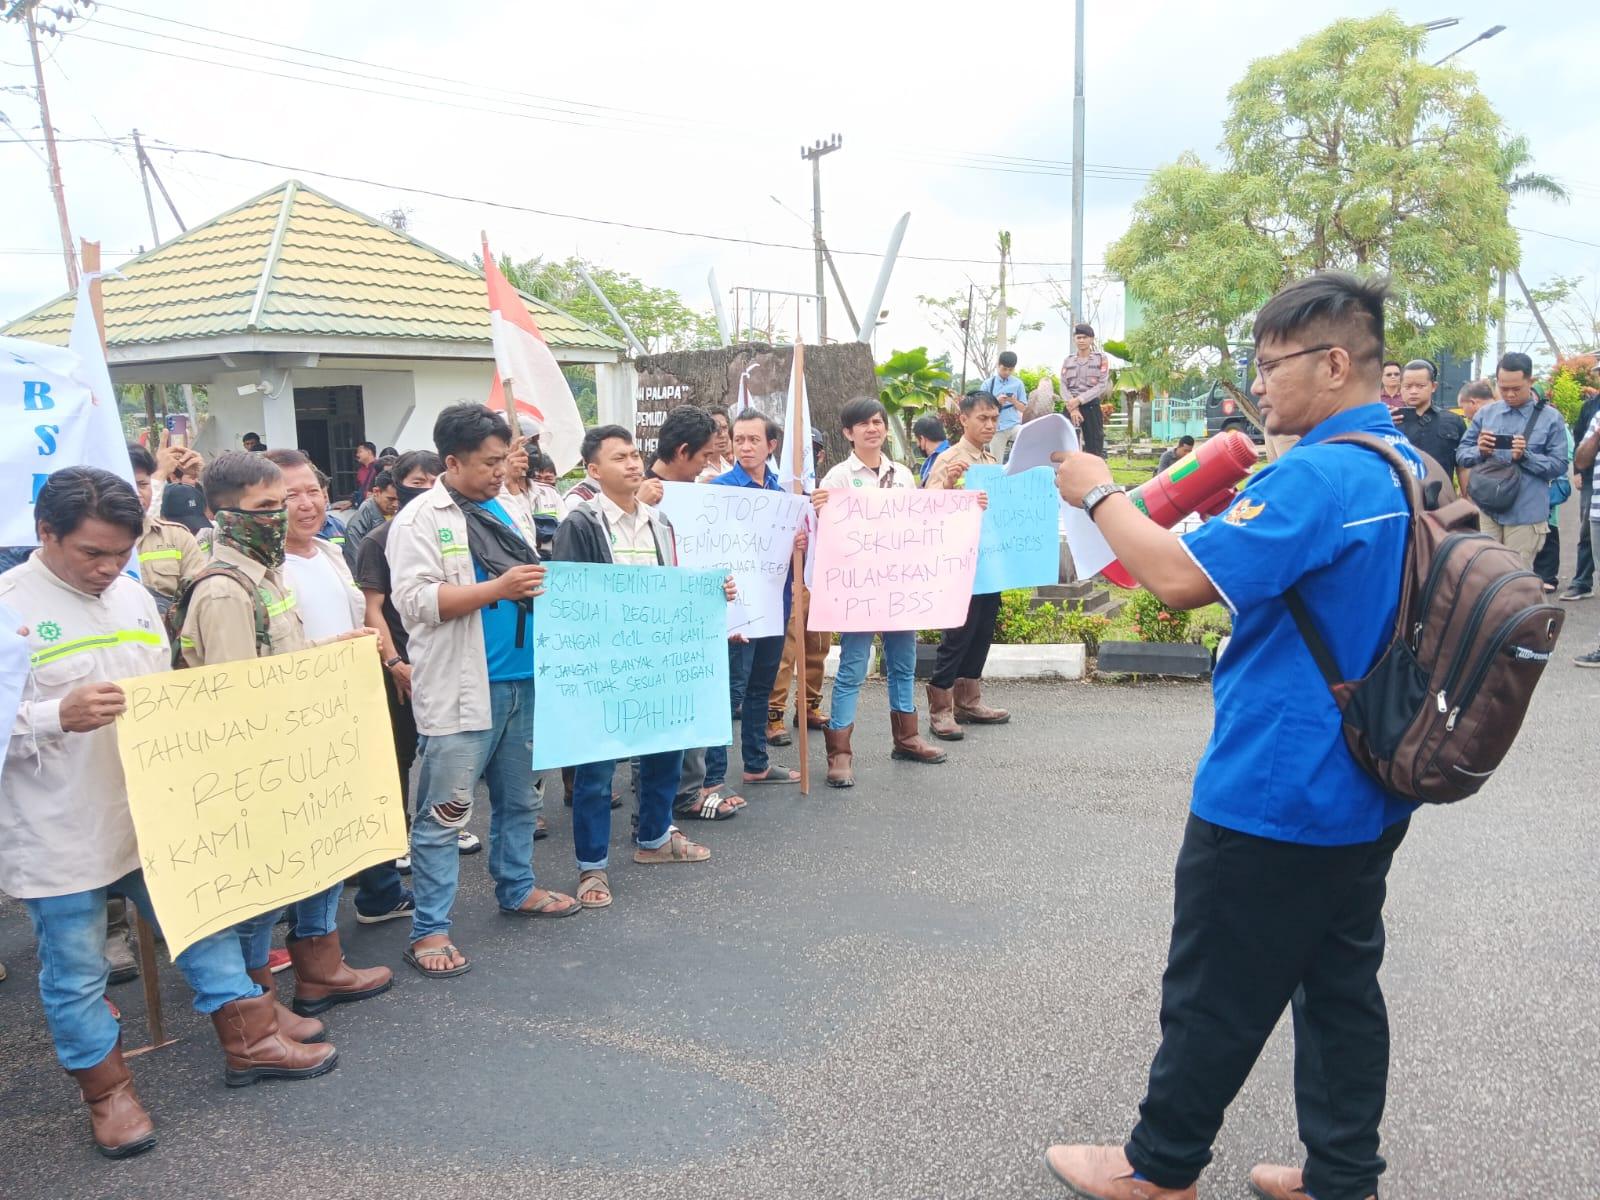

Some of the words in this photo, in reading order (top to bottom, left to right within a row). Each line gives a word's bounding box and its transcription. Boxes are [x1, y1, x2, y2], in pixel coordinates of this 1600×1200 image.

[834, 495, 945, 525] JALANKAN
[844, 520, 944, 558] SEKURITI
[550, 568, 588, 593] KAMI
[603, 569, 667, 594] MEMINTA
[826, 556, 939, 591] PULANGKAN
[549, 598, 608, 621] SESUAI
[552, 632, 600, 650] JANGAN
[651, 627, 674, 645] GAJI
[554, 661, 598, 679] JANGAN
[610, 656, 654, 675] BANYAK
[556, 683, 579, 697] TAPI
[584, 681, 619, 697] TIDAK
[626, 673, 666, 692] SESUAI
[675, 664, 714, 684] DENGAN
[131, 672, 235, 722] BAYAR
[284, 679, 350, 735] SESUAI
[191, 714, 361, 819] REGULASI
[167, 808, 251, 871] KAMI
[281, 781, 354, 835] MINTA
[186, 794, 390, 914] TRANSPORTASI
